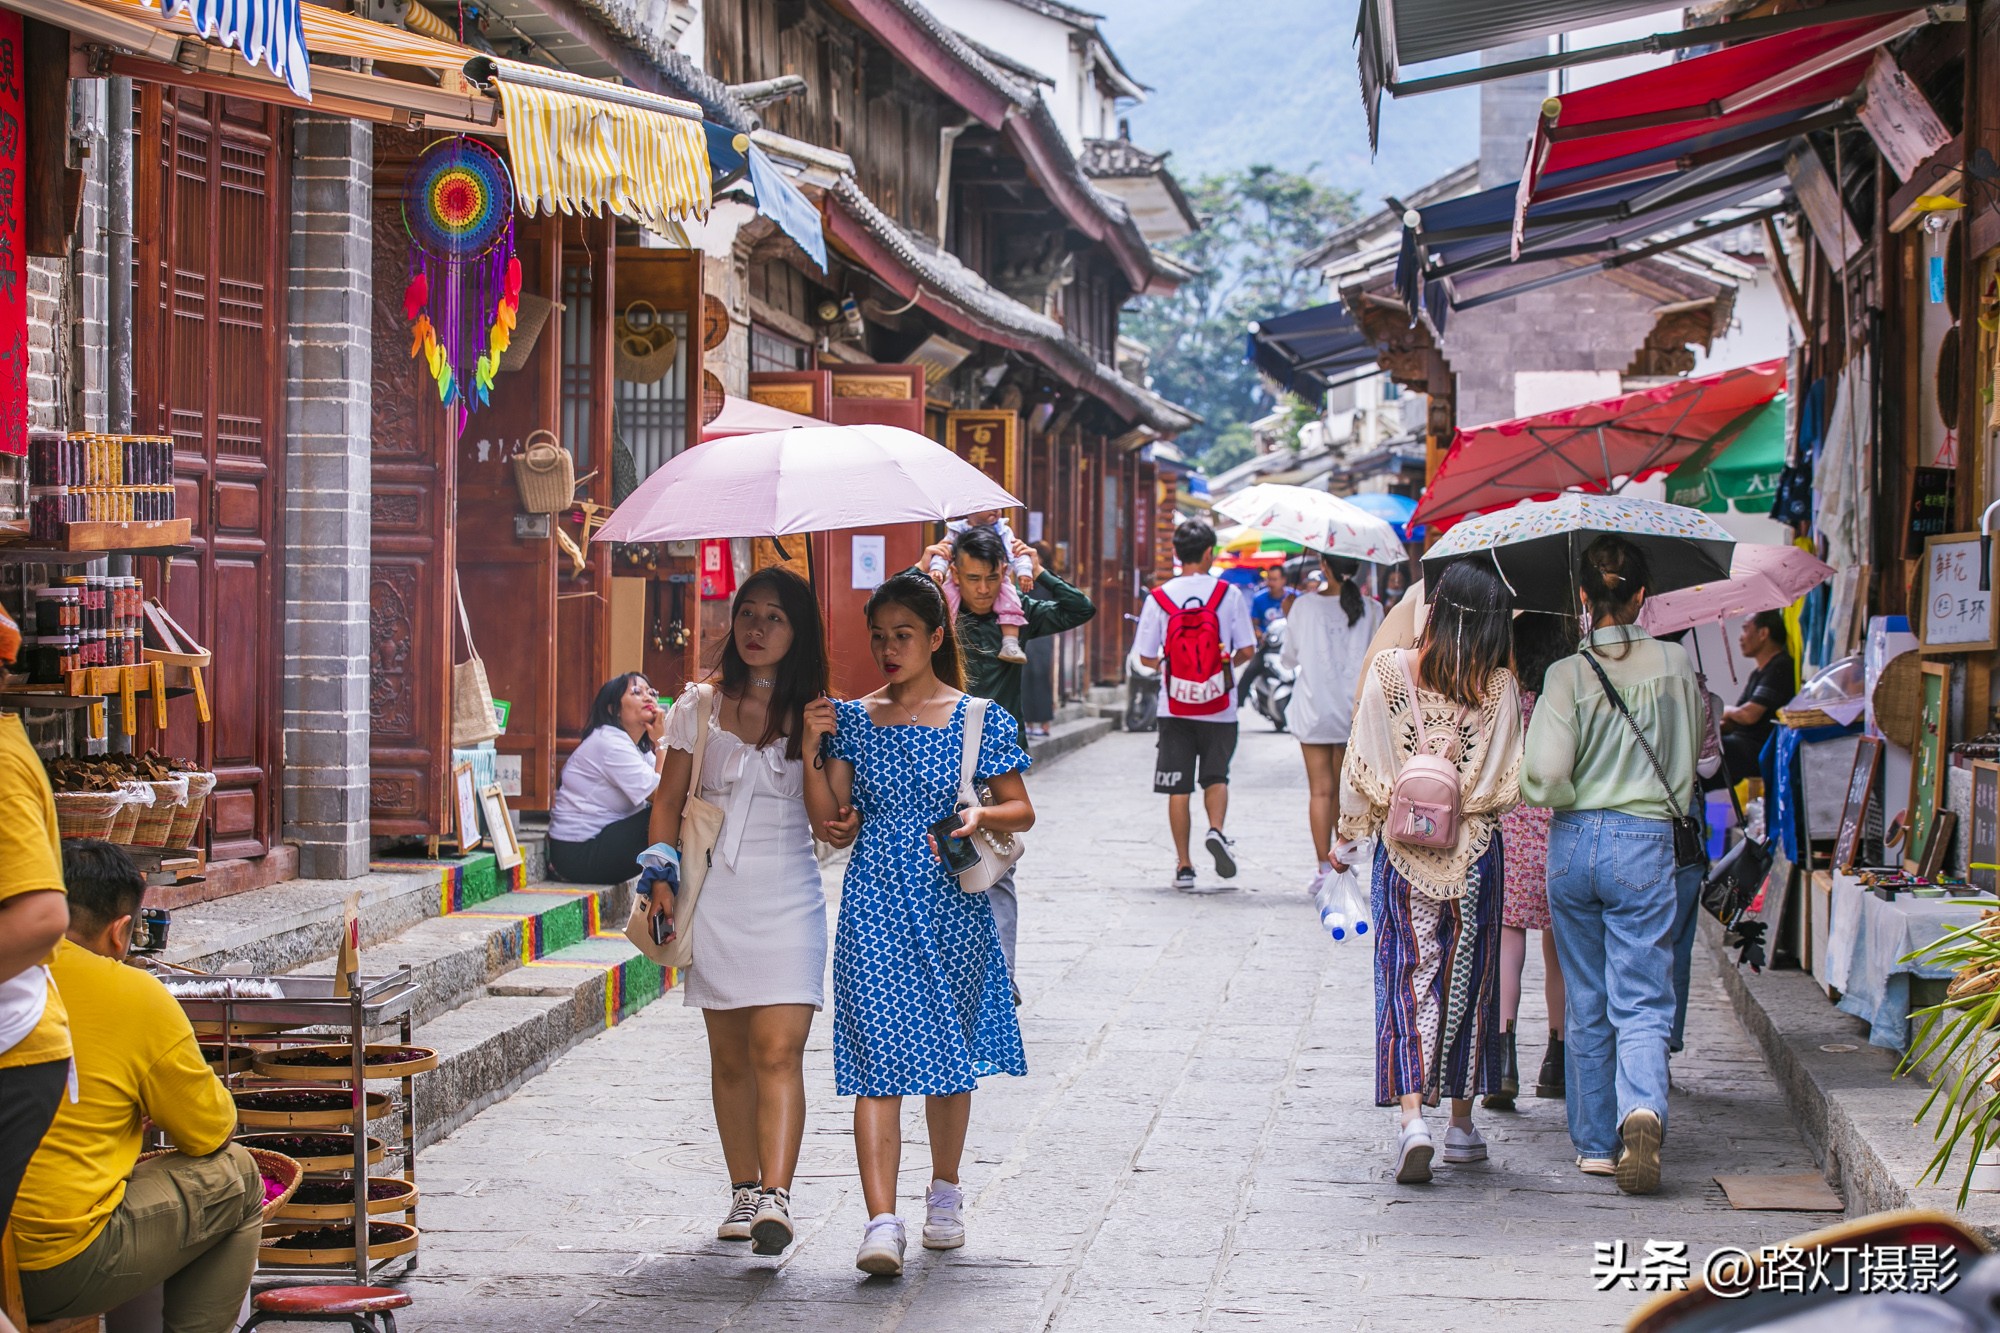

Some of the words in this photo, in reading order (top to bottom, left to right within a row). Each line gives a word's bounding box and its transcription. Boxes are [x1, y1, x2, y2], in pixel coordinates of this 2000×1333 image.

[962, 422, 997, 478] 百年
[1935, 551, 1968, 584] 鲜花
[1956, 597, 1986, 624] 耳环
[1175, 681, 1221, 701] HEYA
